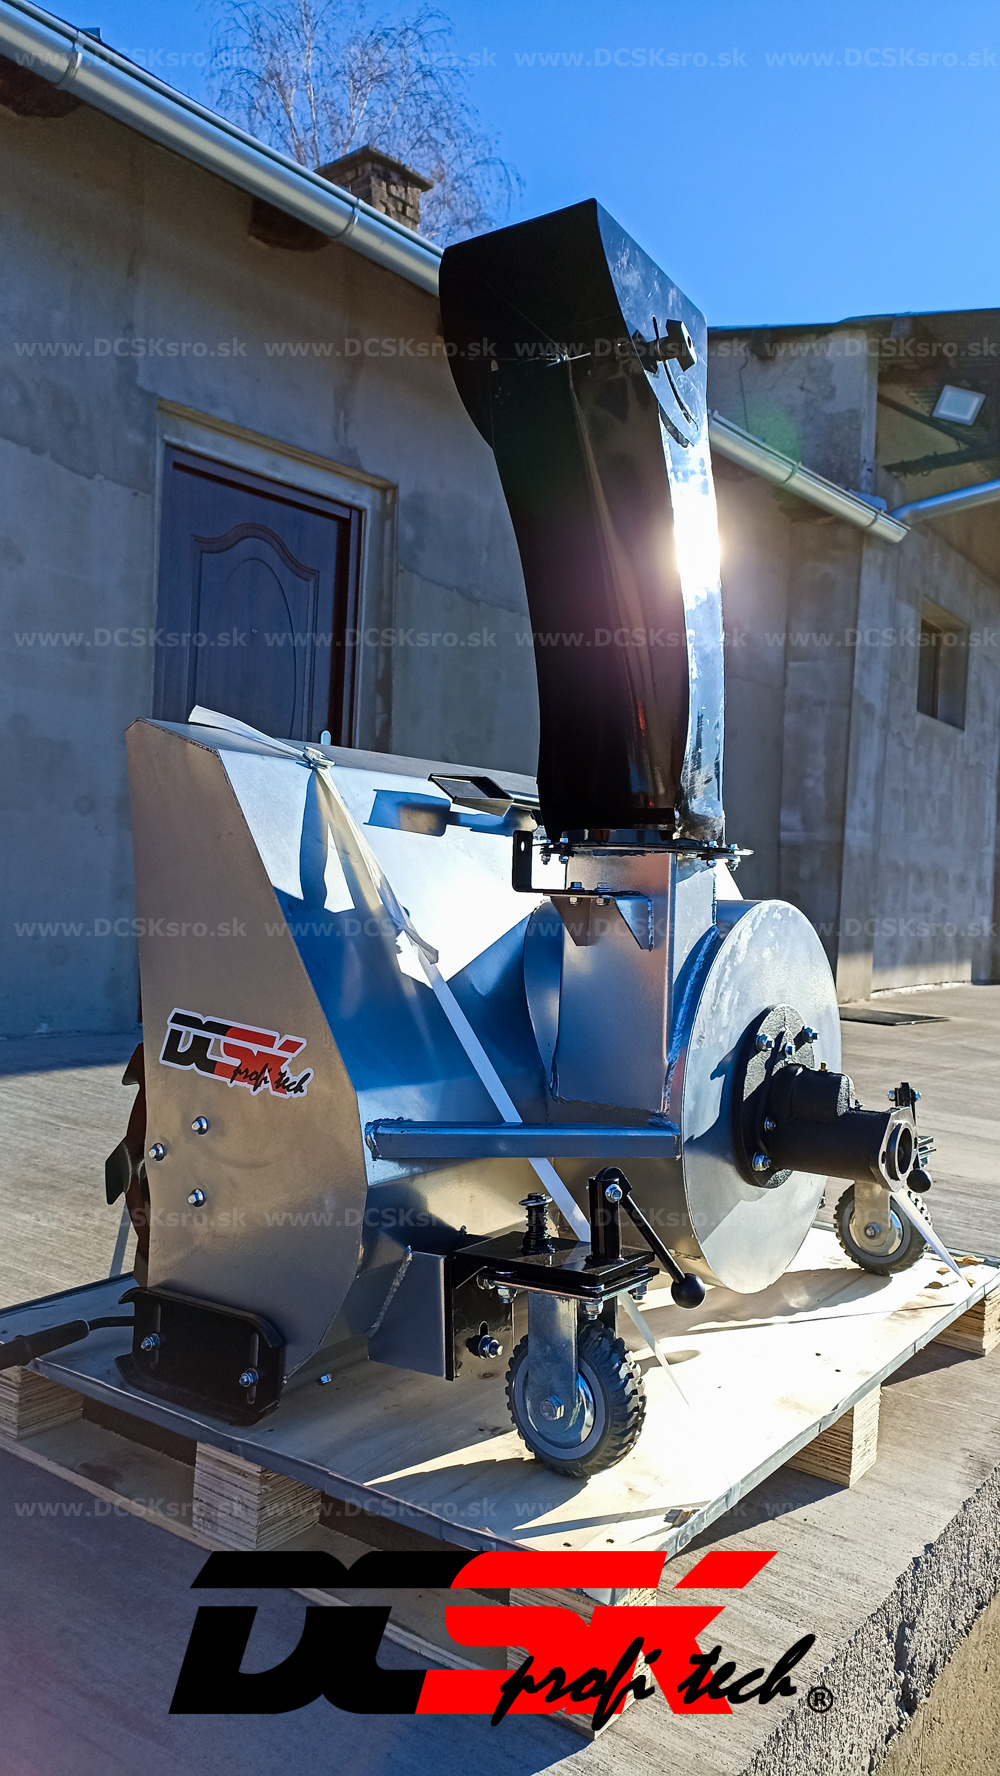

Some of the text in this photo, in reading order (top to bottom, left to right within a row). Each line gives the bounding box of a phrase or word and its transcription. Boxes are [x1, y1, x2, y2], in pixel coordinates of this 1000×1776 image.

[162, 1012, 303, 1094] DCSK
[230, 1063, 310, 1094] profi tech
